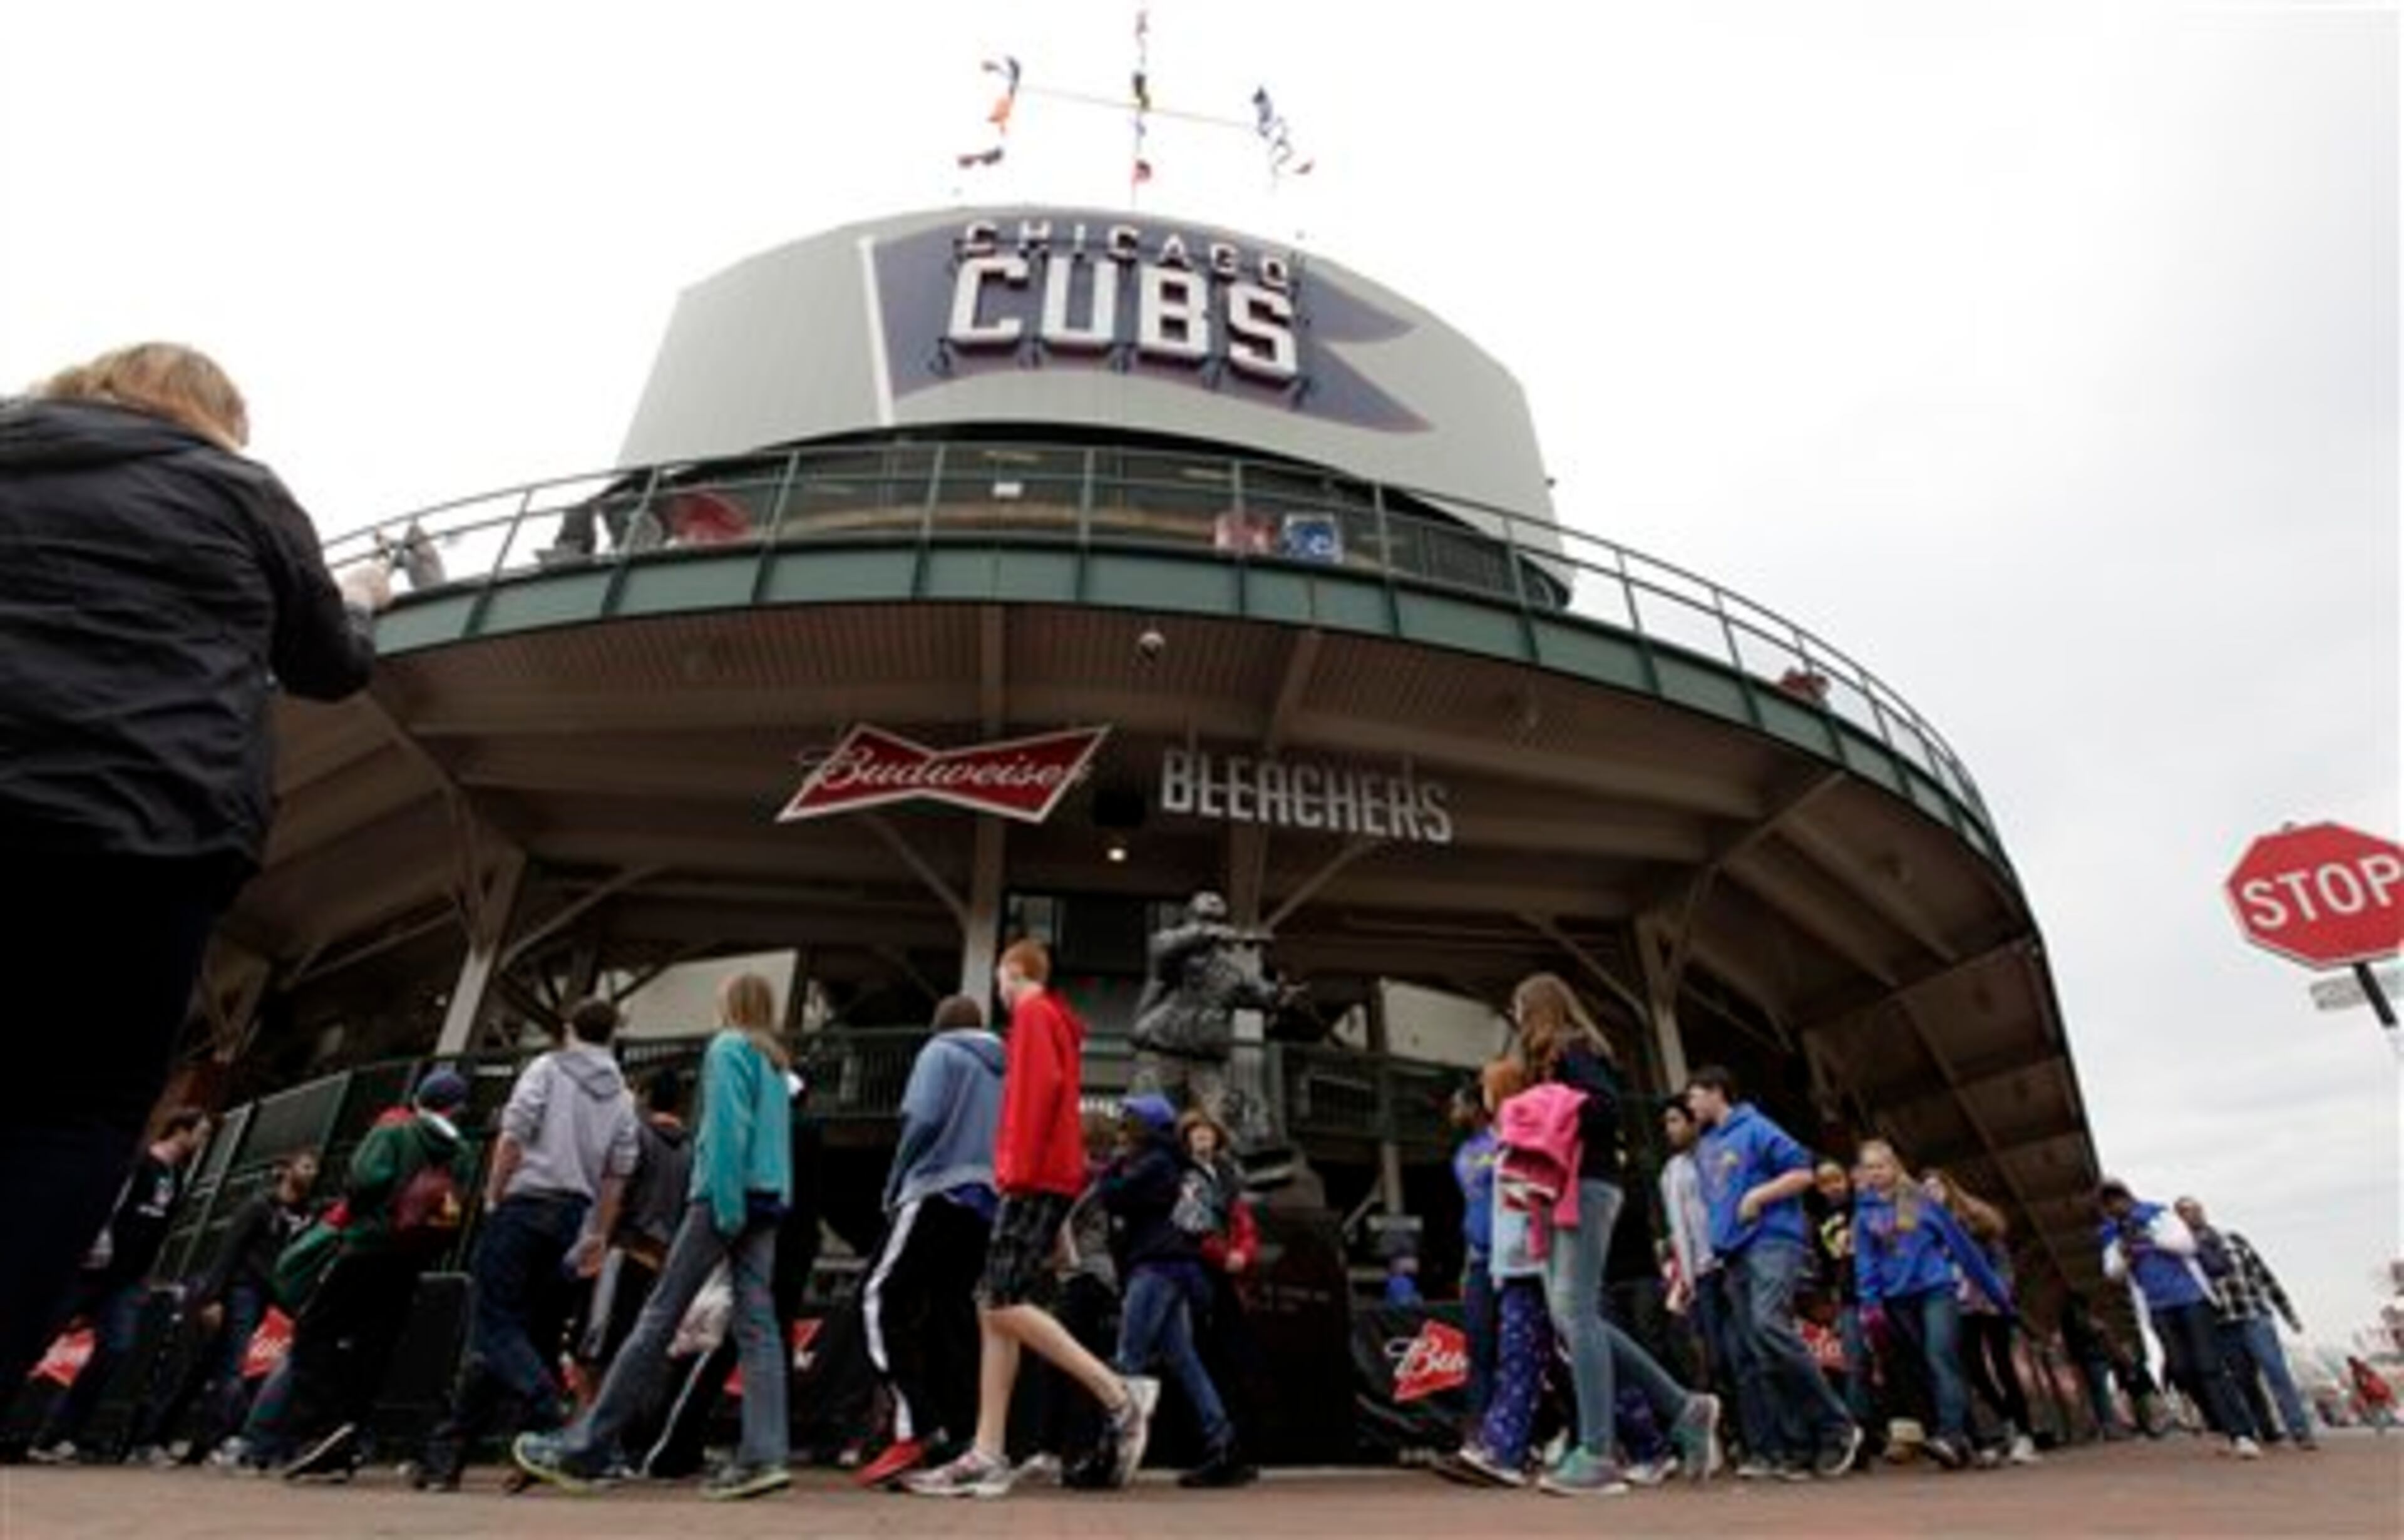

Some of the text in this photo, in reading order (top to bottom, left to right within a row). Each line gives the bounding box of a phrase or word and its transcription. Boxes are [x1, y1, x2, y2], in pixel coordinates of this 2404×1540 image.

[964, 219, 1290, 289] CHICAGO
[947, 255, 1299, 379] CUBS
[798, 746, 1091, 791] Budweiser
[1161, 747, 1453, 843] BLEACHERS
[2241, 853, 2401, 929] STOP
